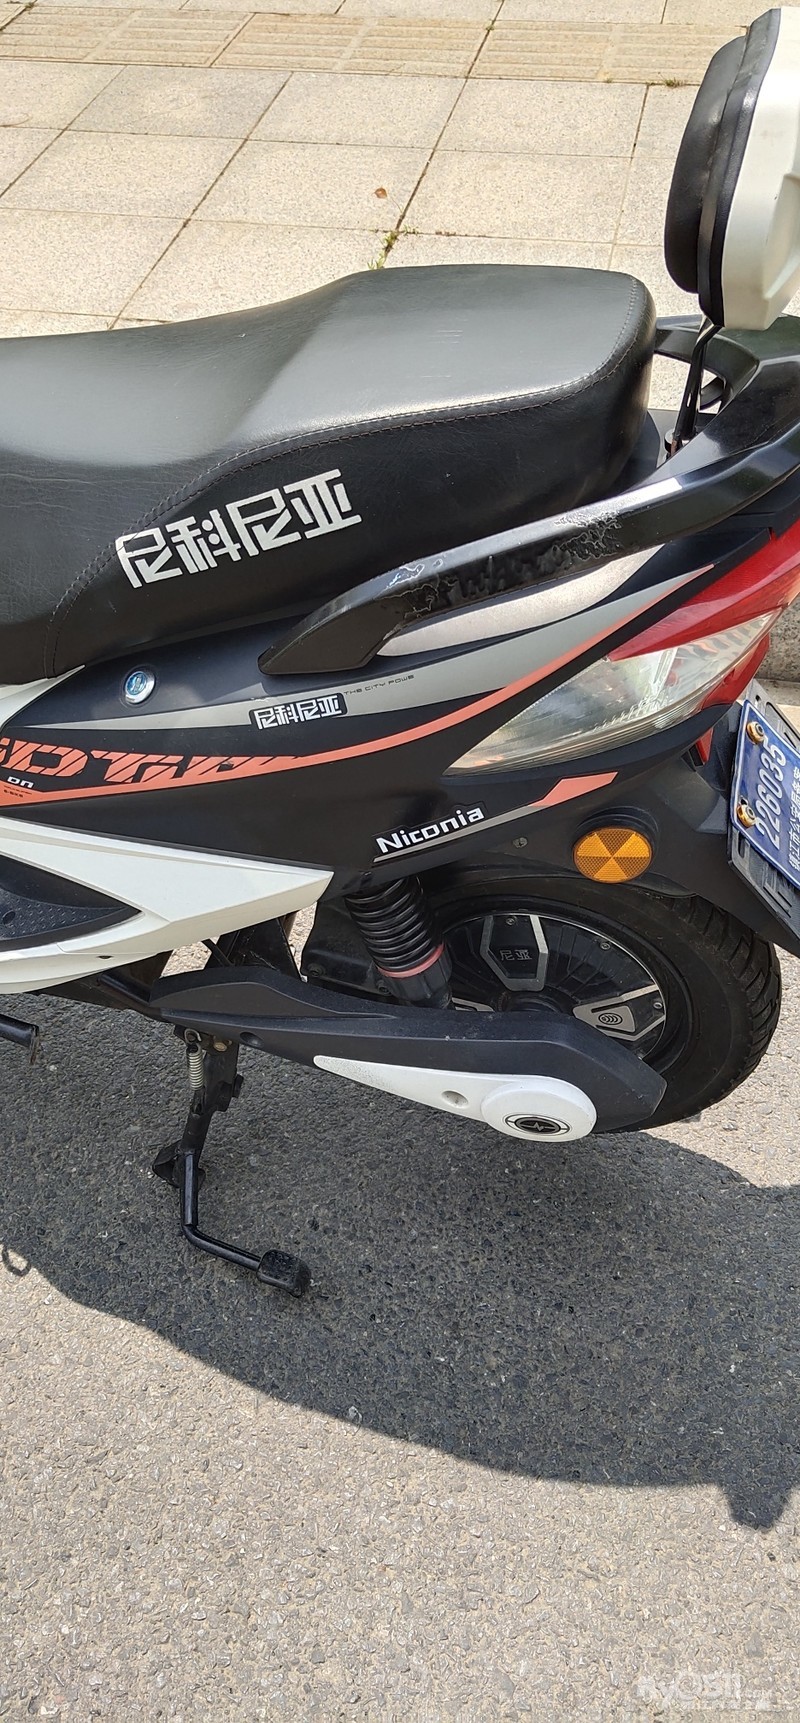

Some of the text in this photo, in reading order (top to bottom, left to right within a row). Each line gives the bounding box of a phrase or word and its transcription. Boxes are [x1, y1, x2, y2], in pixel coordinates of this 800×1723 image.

[115, 468, 362, 588] 尼科尼亚
[253, 694, 342, 730] 尼科尼亚
[376, 807, 485, 854] Niconia
[755, 736, 786, 850] 226035
